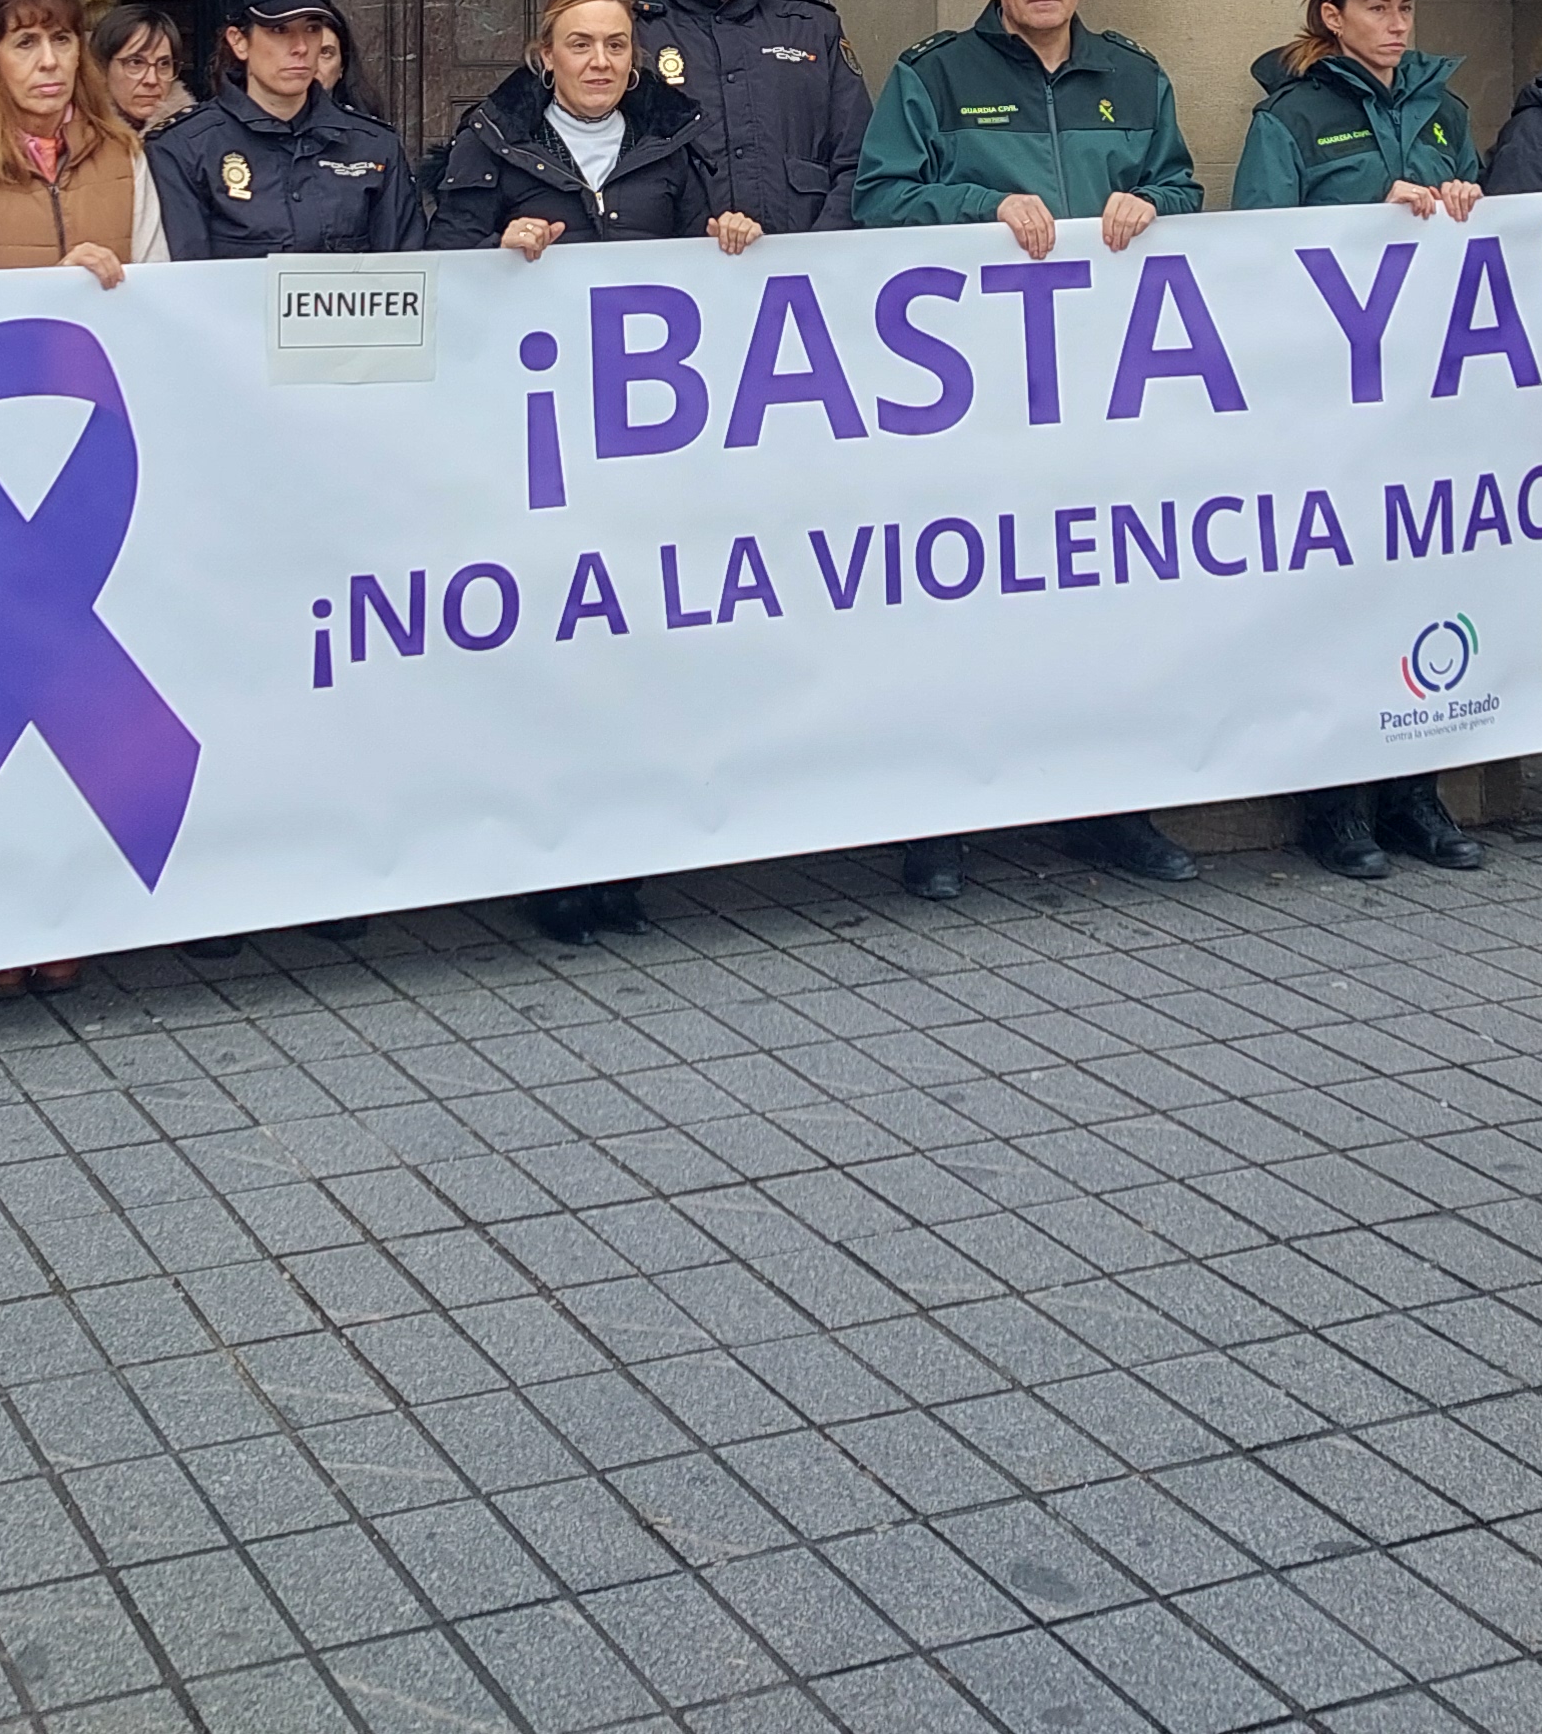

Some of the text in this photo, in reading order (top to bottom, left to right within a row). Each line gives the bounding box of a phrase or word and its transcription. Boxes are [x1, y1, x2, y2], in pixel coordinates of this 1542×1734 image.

[960, 107, 997, 115] GUARDIA
[1317, 133, 1353, 145] GUARDIA
[281, 290, 420, 320] JENNIFER
[519, 259, 1248, 510] ¡BASTA
[312, 563, 520, 688] ¡NO
[555, 552, 629, 641] A
[660, 536, 783, 630] LA
[808, 490, 1353, 610] VIOLENCIA
[1380, 693, 1500, 730] Pacto de Estado
[1385, 730, 1413, 743] contra
[1414, 728, 1422, 739] la
[1424, 724, 1457, 738] violencia
[1459, 721, 1468, 731] de
